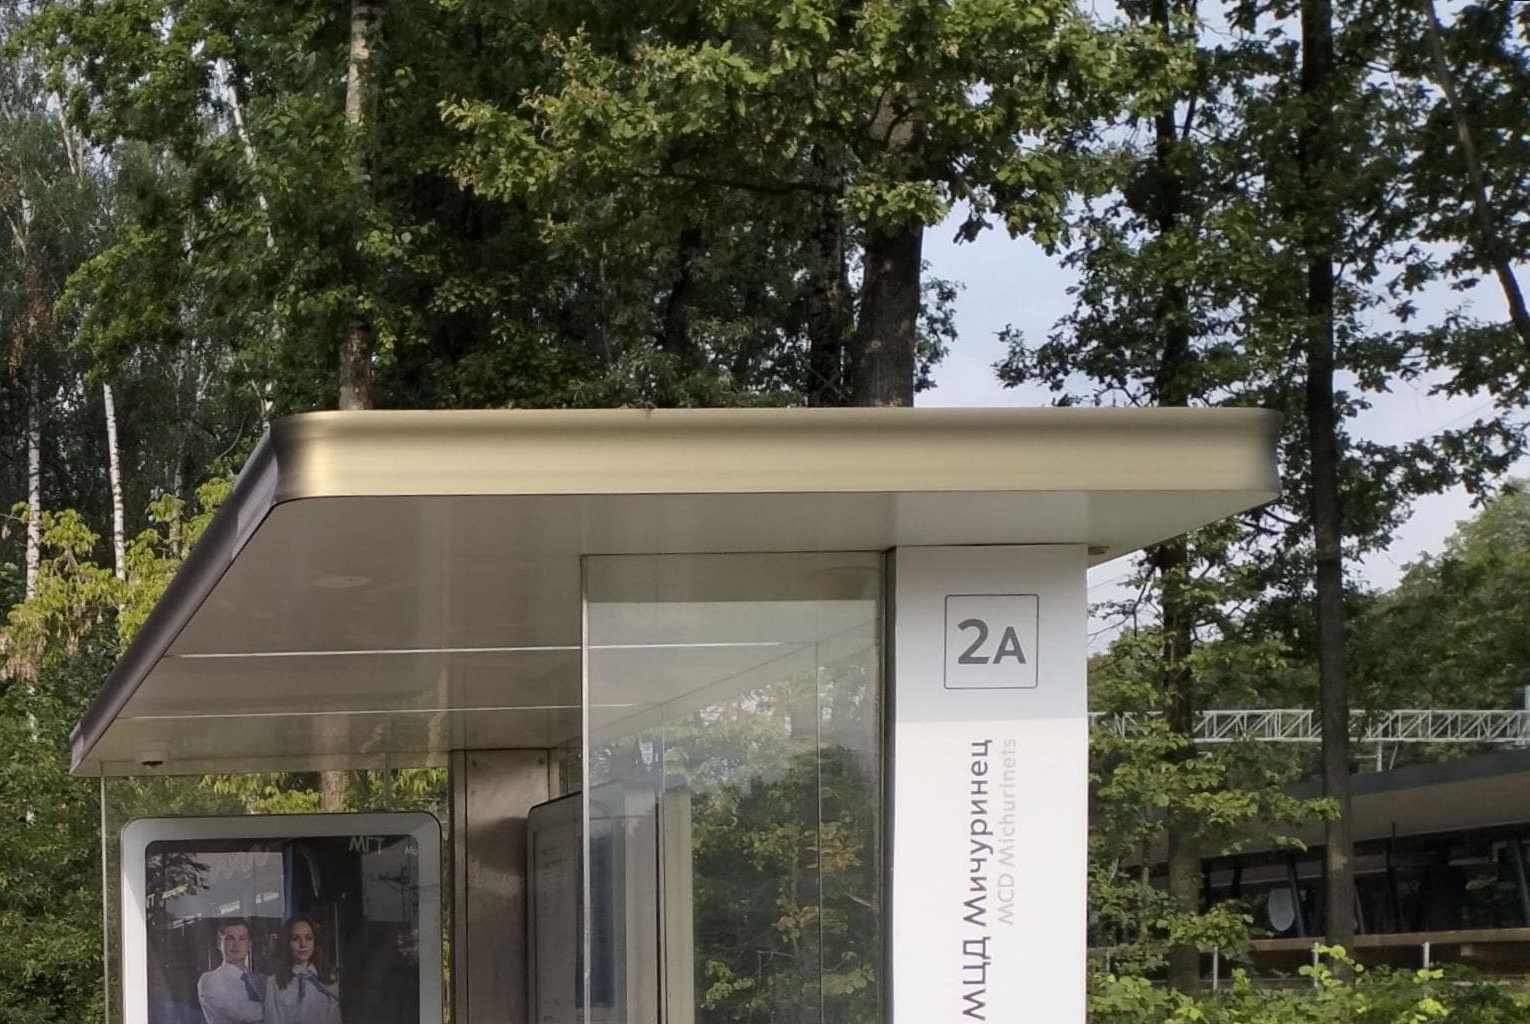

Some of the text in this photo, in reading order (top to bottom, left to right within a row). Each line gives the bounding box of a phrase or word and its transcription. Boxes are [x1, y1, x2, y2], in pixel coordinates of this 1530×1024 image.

[962, 738, 994, 1021] МЦД Мичуринец
[997, 738, 1016, 925] MCD Michurinets
